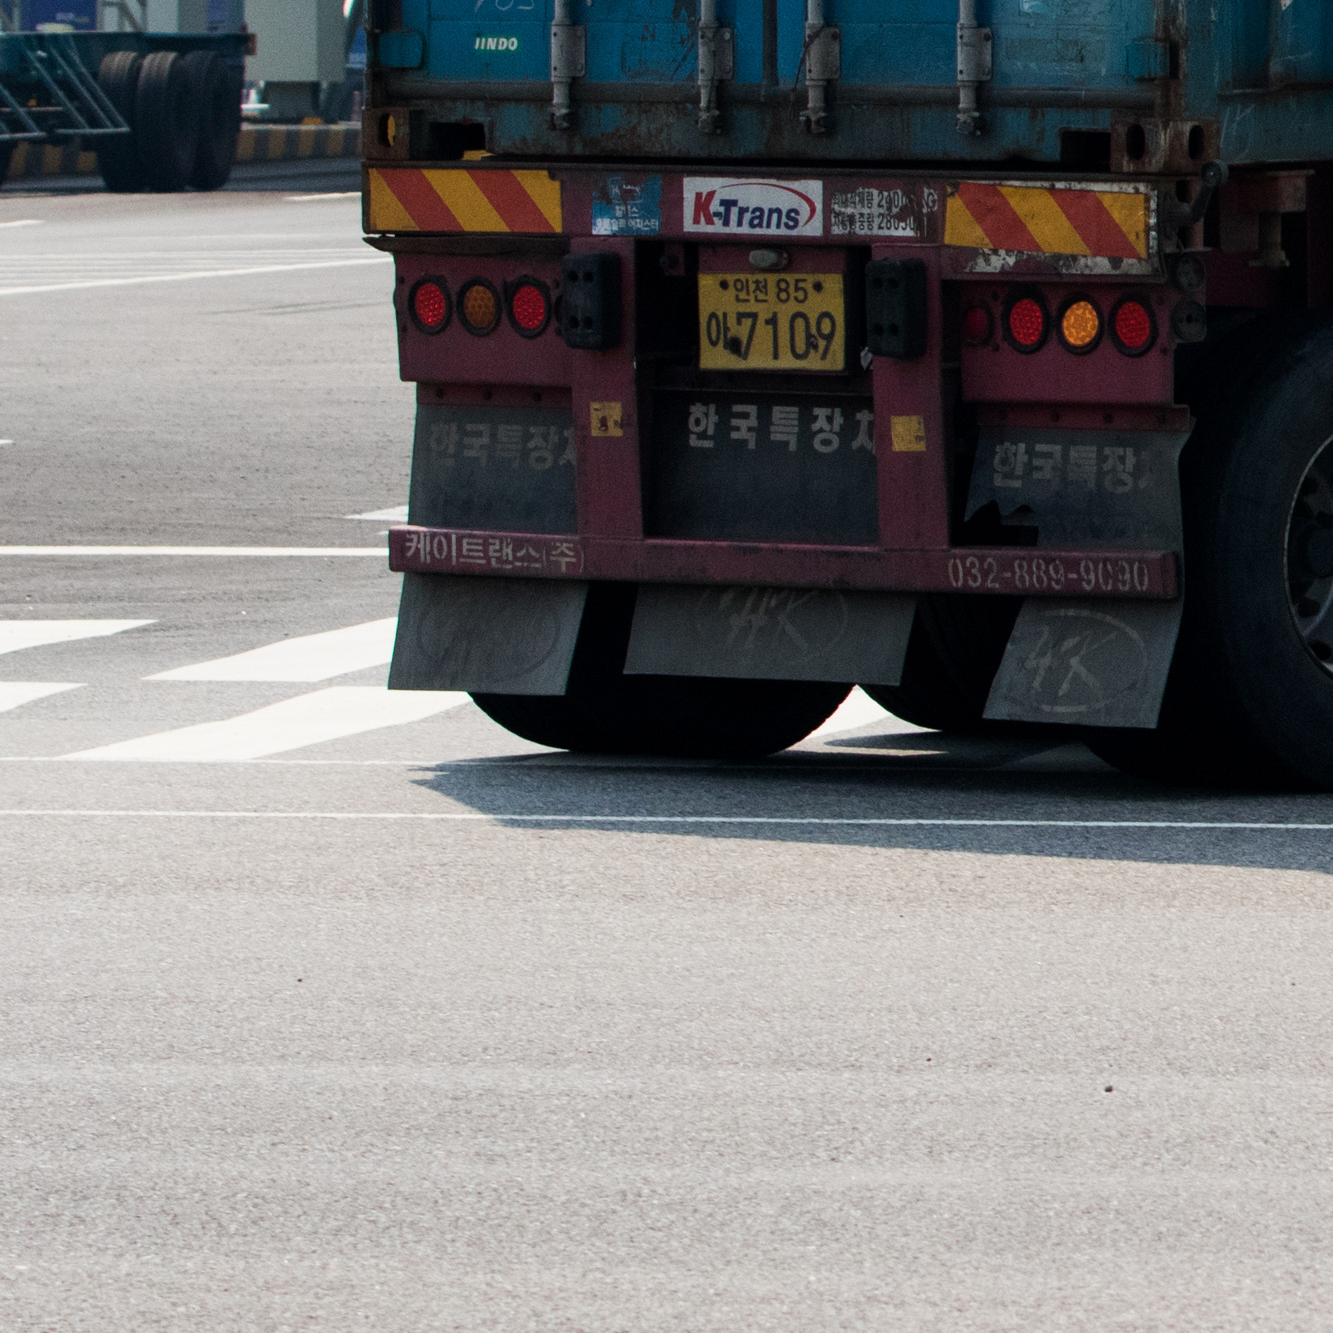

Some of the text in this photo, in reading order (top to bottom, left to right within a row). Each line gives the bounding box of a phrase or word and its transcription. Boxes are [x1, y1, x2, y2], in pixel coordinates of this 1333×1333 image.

[692, 188, 800, 230] K-Trans
[733, 277, 809, 303] 인천 85
[405, 531, 584, 573] 케이트랜스(주)
